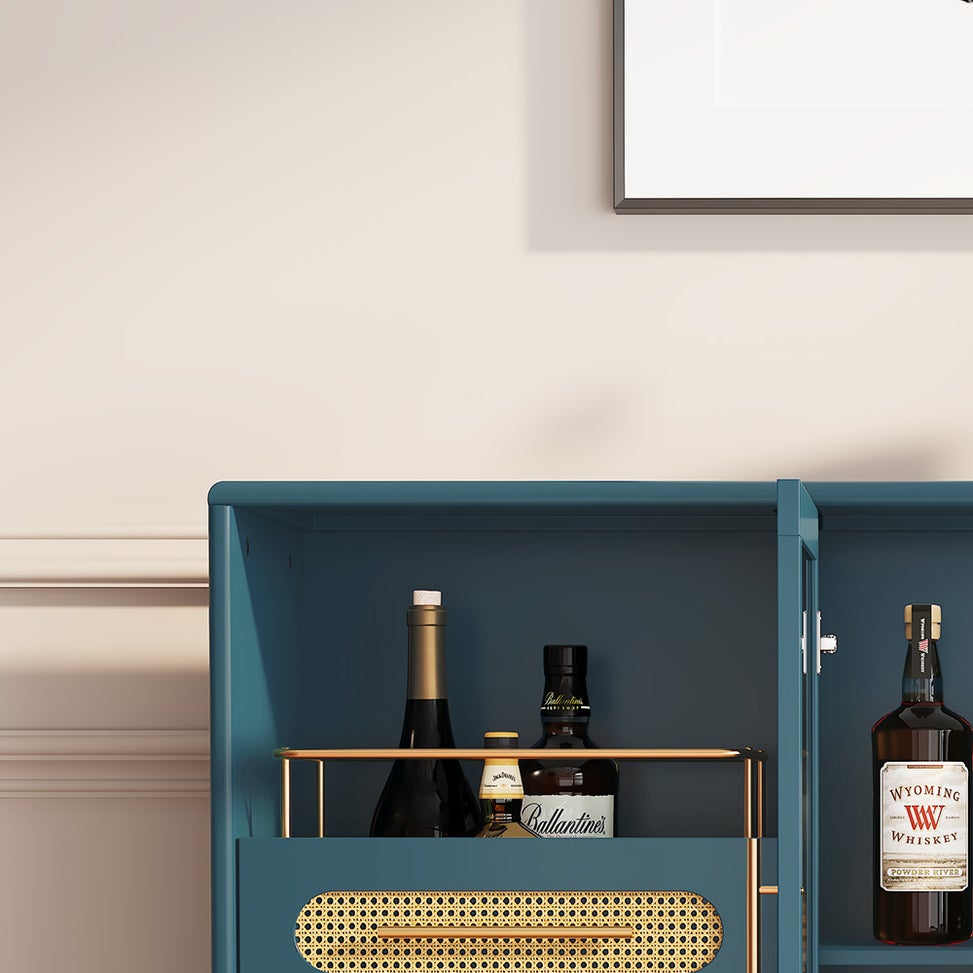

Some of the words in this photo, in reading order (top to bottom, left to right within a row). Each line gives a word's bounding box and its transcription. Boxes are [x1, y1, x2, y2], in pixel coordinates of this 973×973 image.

[889, 784, 961, 802] WYOMING
[521, 802, 606, 835] Ballantine's
[891, 830, 958, 845] WHISKEY
[891, 868, 931, 876] POWDER
[932, 868, 960, 876] RIVER
